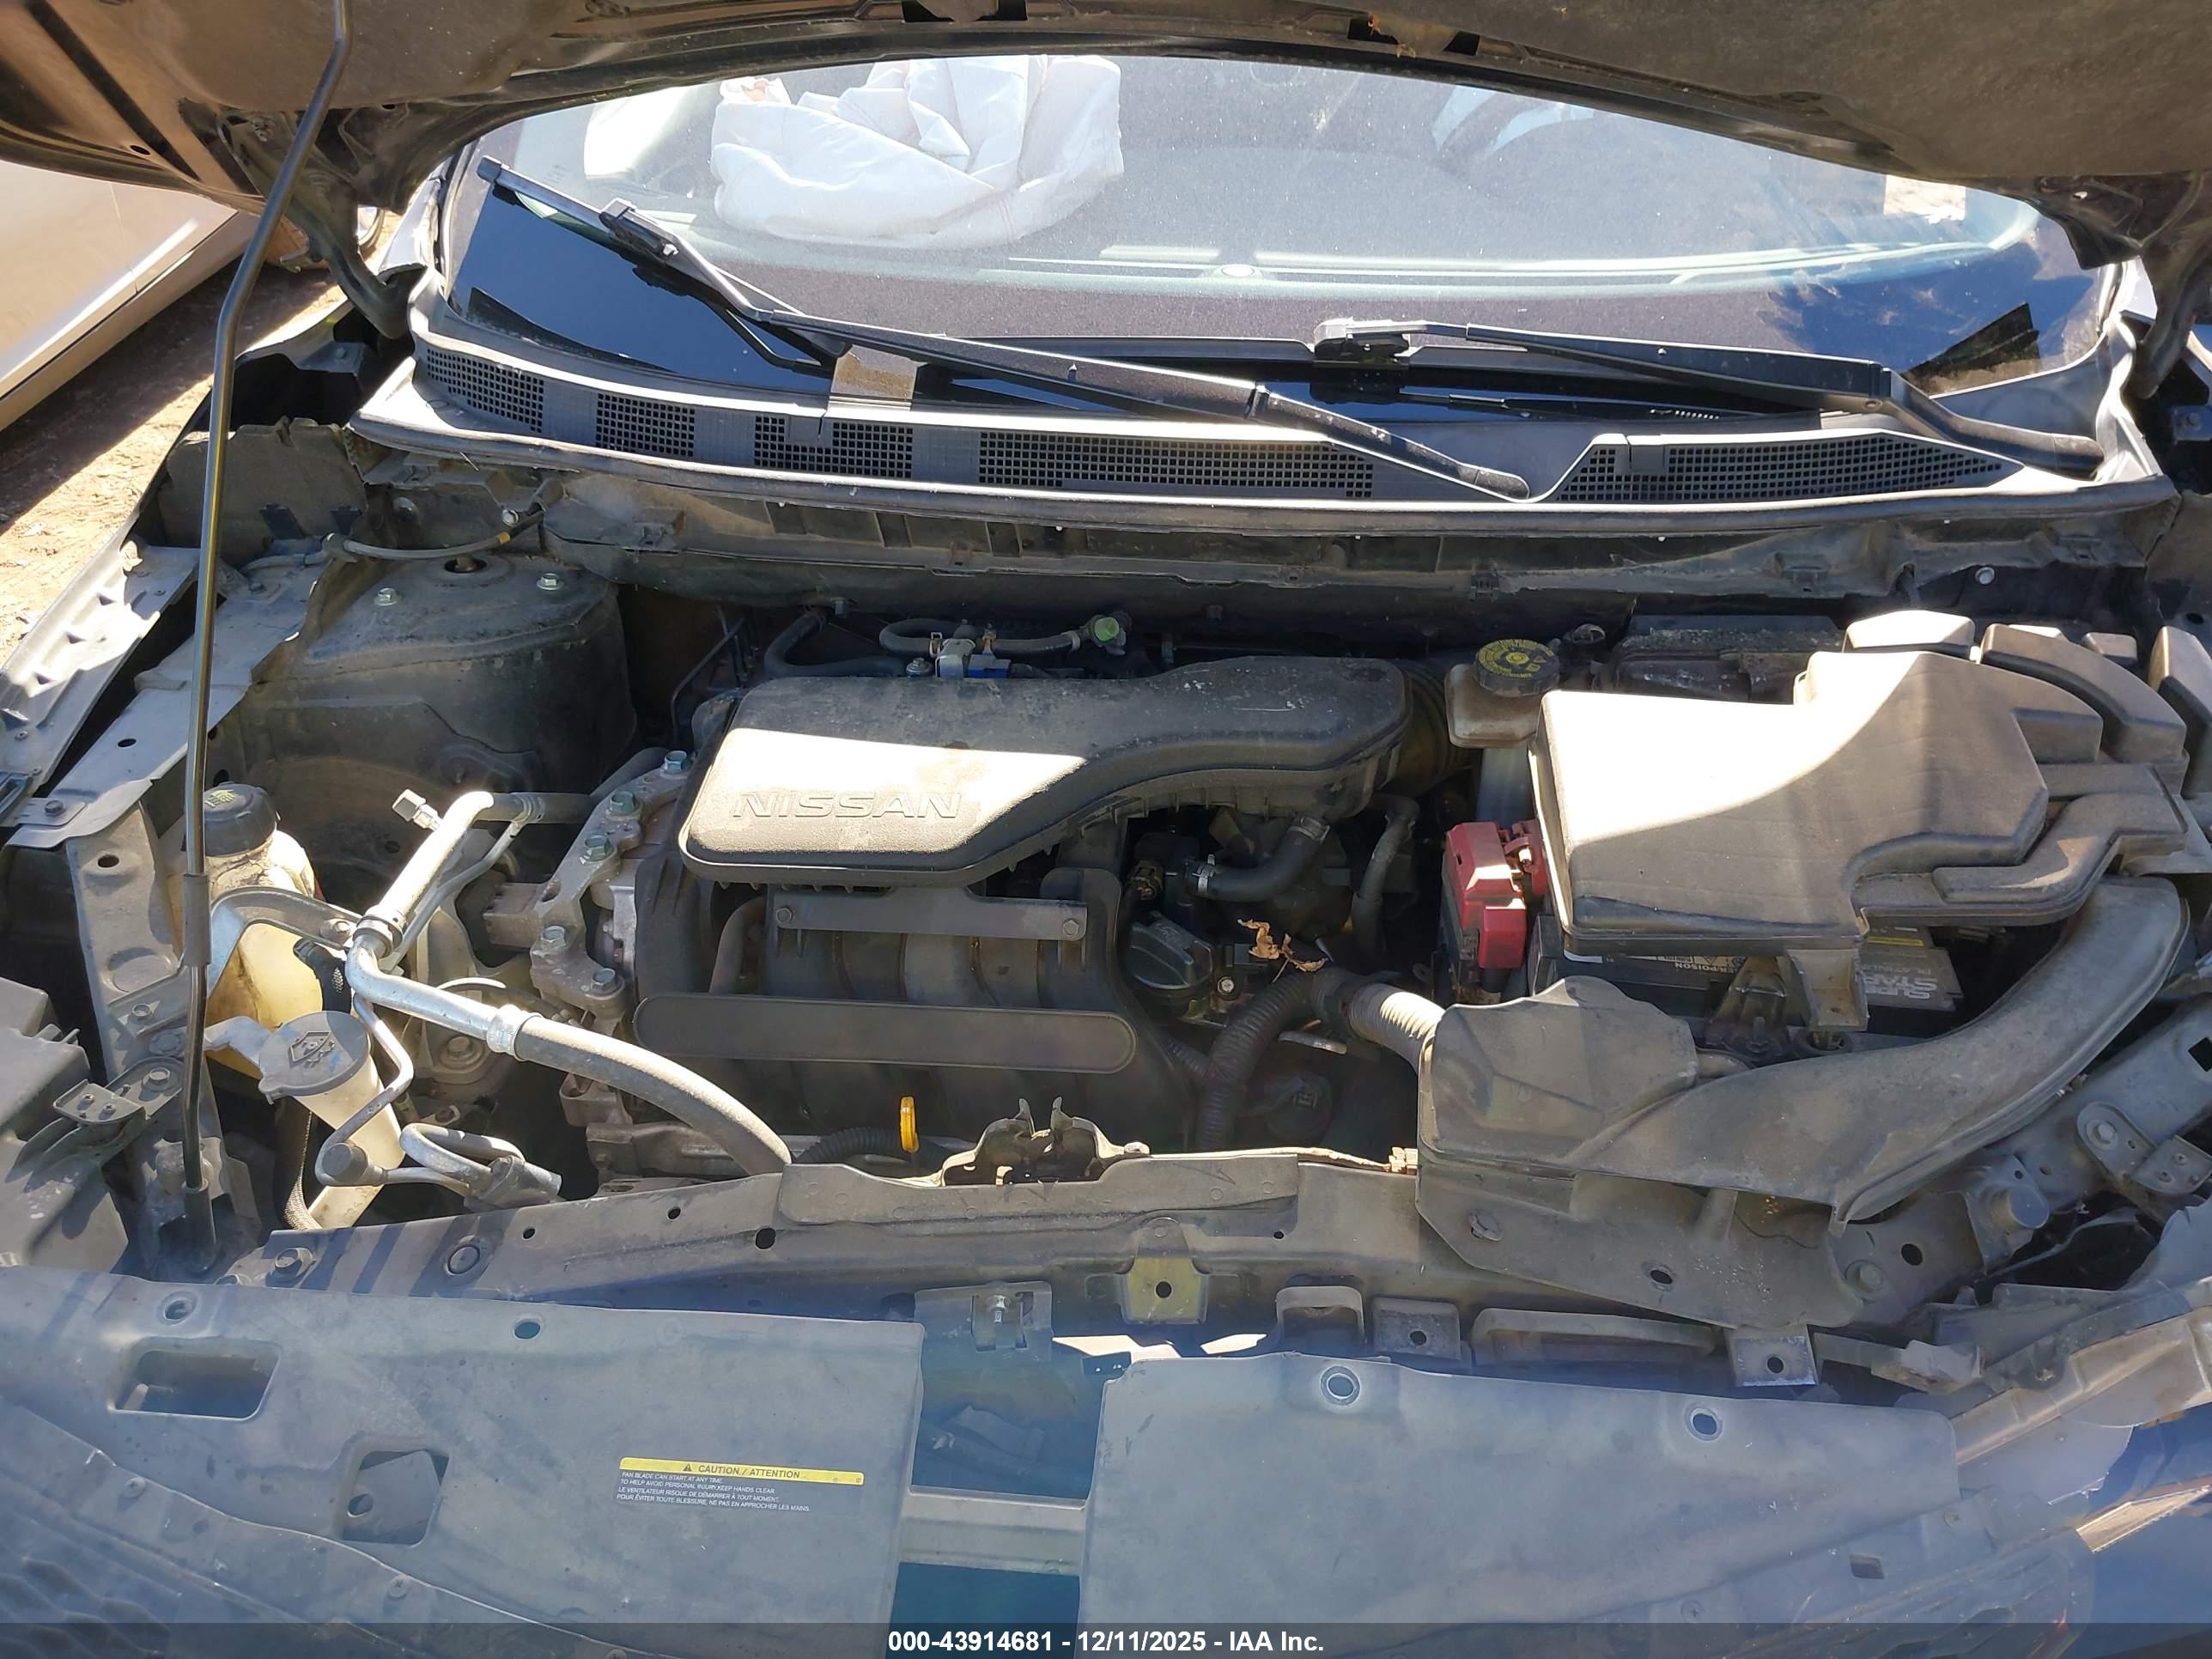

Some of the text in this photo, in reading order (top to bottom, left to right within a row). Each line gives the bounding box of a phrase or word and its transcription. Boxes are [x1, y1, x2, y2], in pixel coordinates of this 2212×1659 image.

[732, 791, 963, 818] NISSAN
[1862, 975, 1937, 991] STAR
[1865, 985, 1930, 999] SUPE
[698, 1464, 739, 1475] CAUTION
[749, 1468, 800, 1479] ATTENTION
[740, 1501, 777, 1510] APPROCHER
